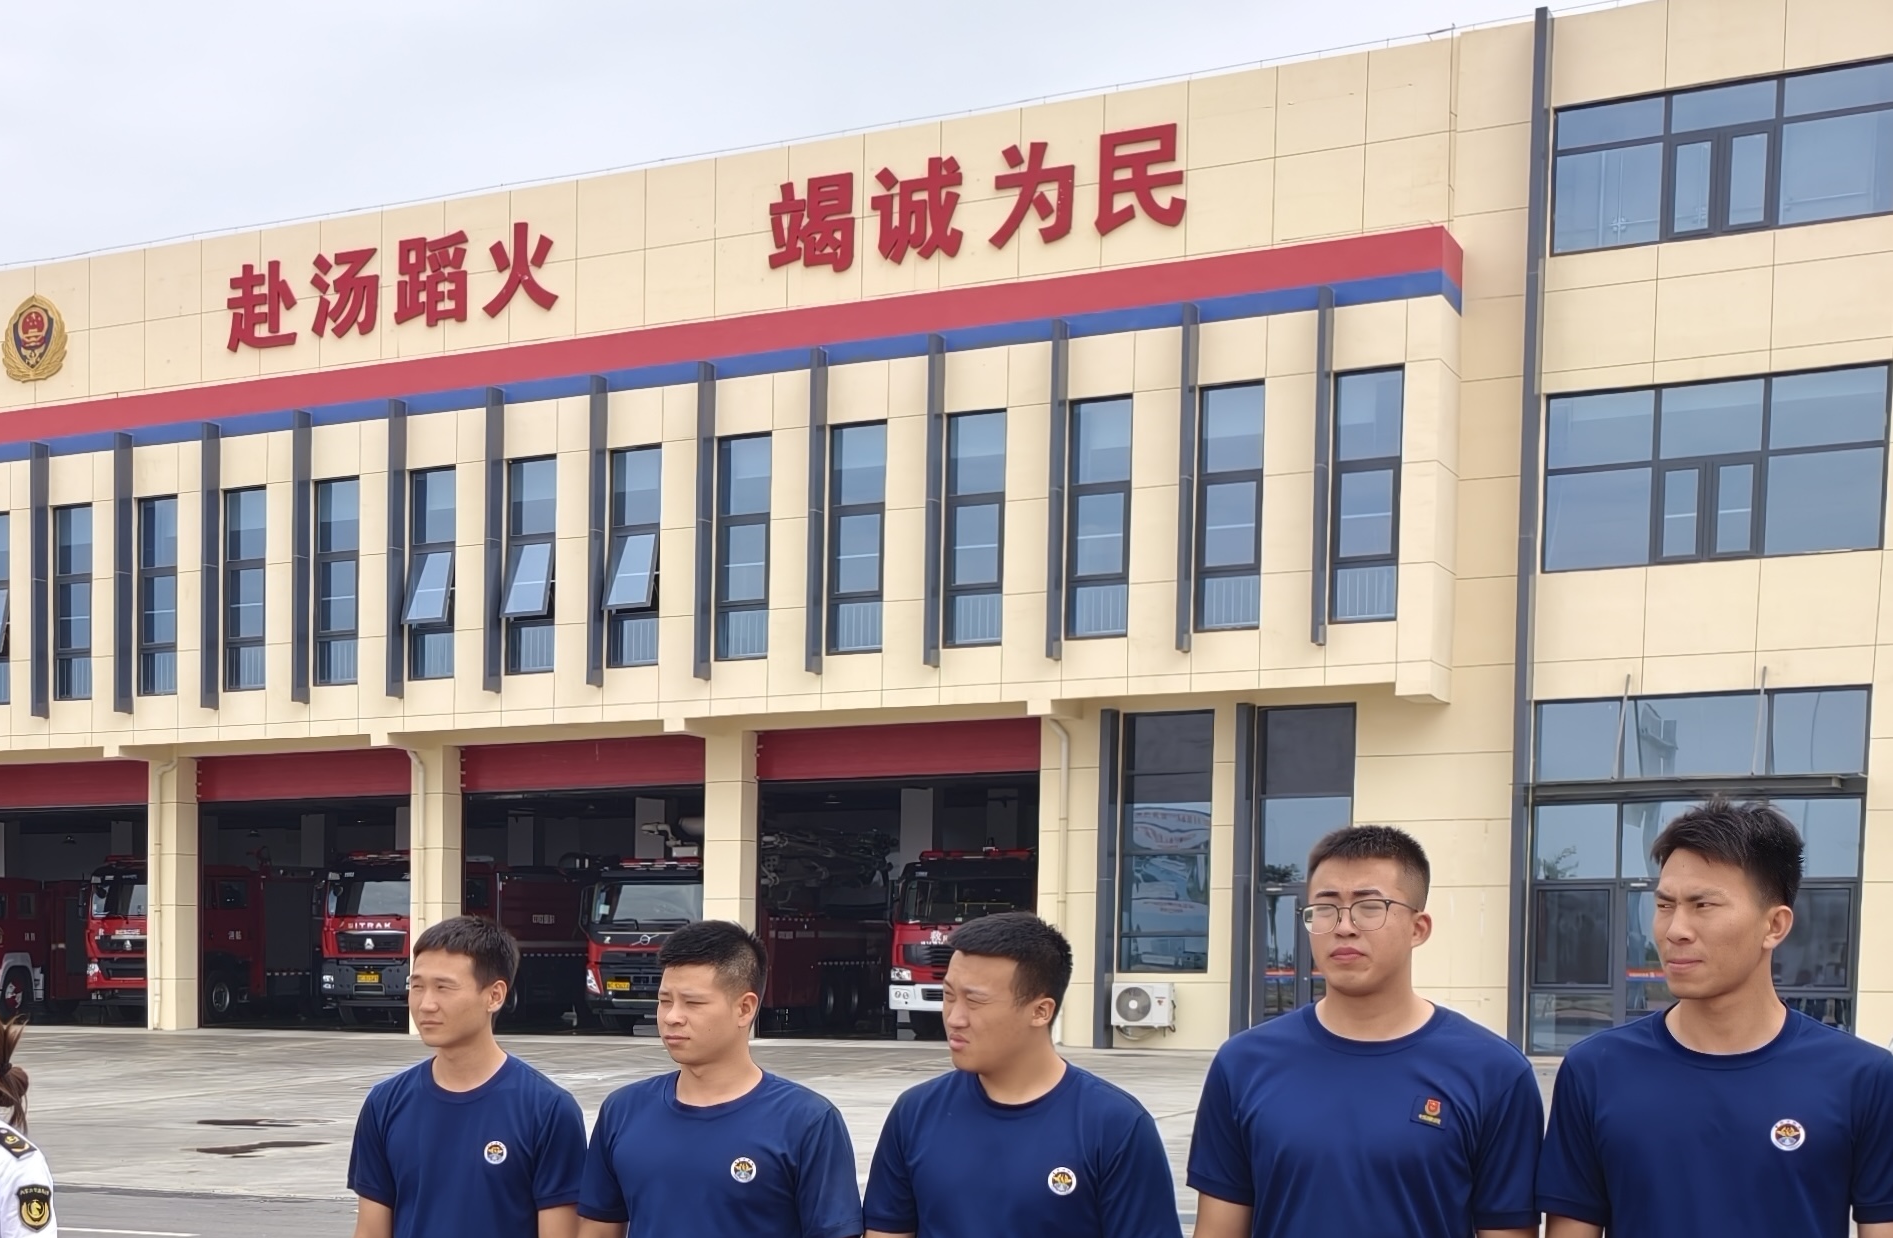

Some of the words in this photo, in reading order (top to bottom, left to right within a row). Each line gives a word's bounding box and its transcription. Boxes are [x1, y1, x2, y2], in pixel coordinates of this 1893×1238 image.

[768, 122, 1187, 274] 竭诚为民
[225, 221, 558, 353] 赴汤蹈火
